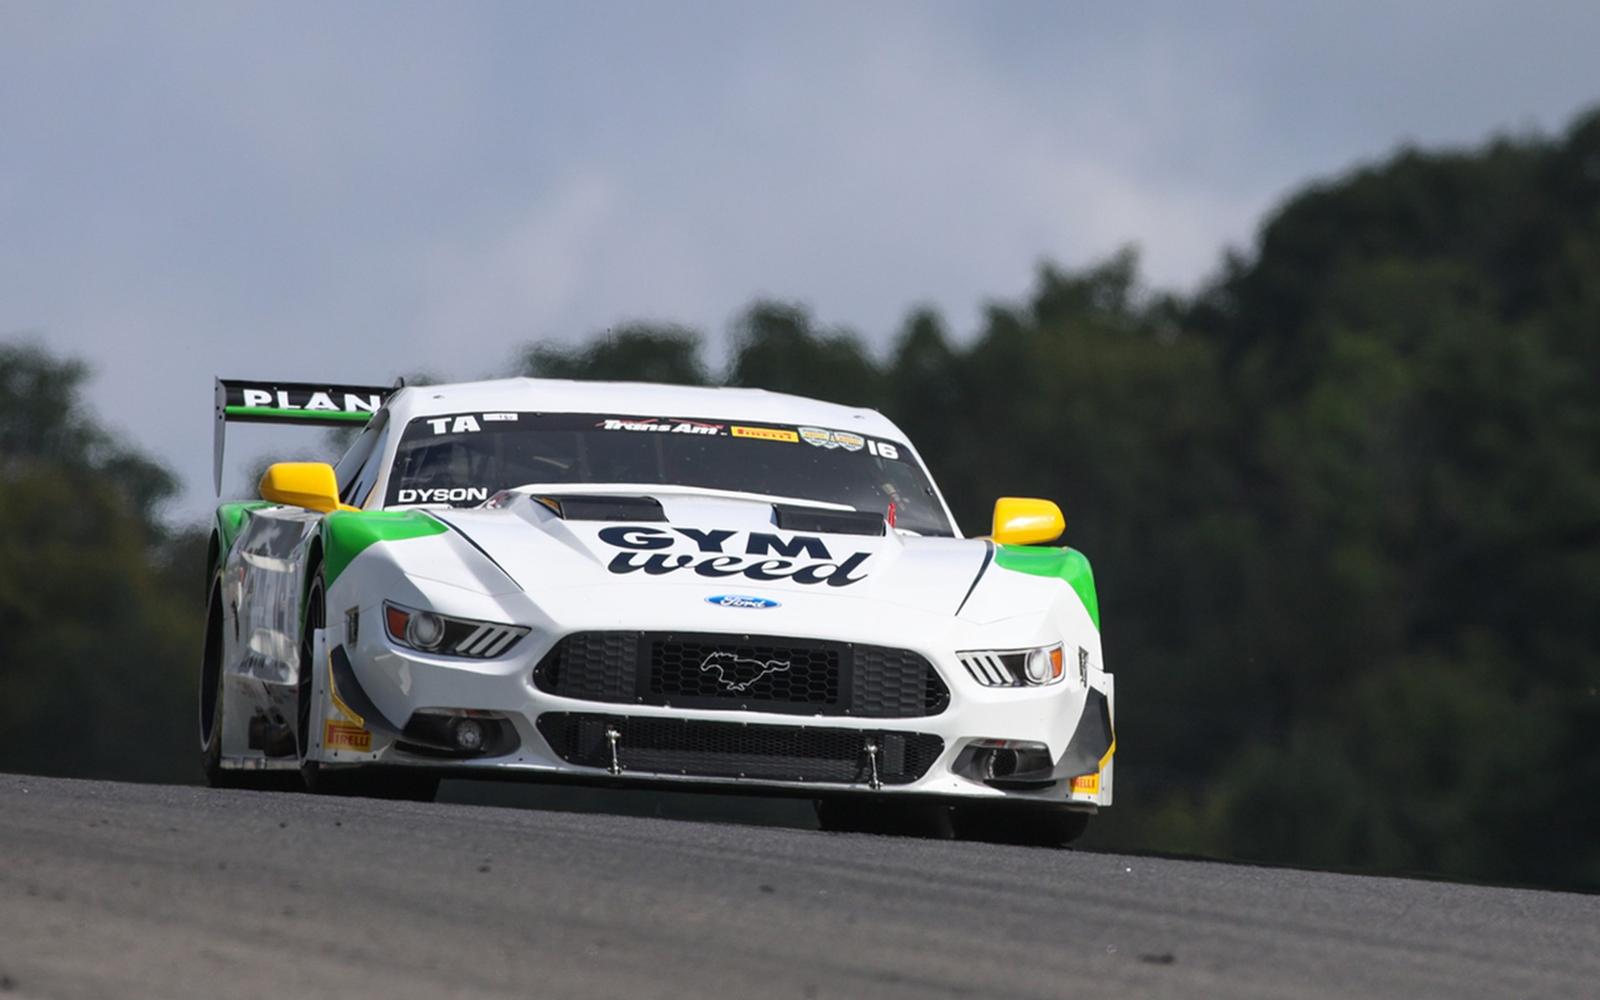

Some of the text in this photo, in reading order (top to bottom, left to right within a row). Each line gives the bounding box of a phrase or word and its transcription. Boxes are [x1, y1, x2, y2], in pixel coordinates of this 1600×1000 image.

[427, 415, 481, 434] TA
[603, 419, 718, 435] Trans Am
[866, 439, 899, 460] 16
[398, 487, 488, 503] DYSON
[597, 525, 833, 560] GYM
[607, 551, 873, 587] weed
[720, 594, 767, 609] Ford
[327, 723, 370, 747] PIRELLI
